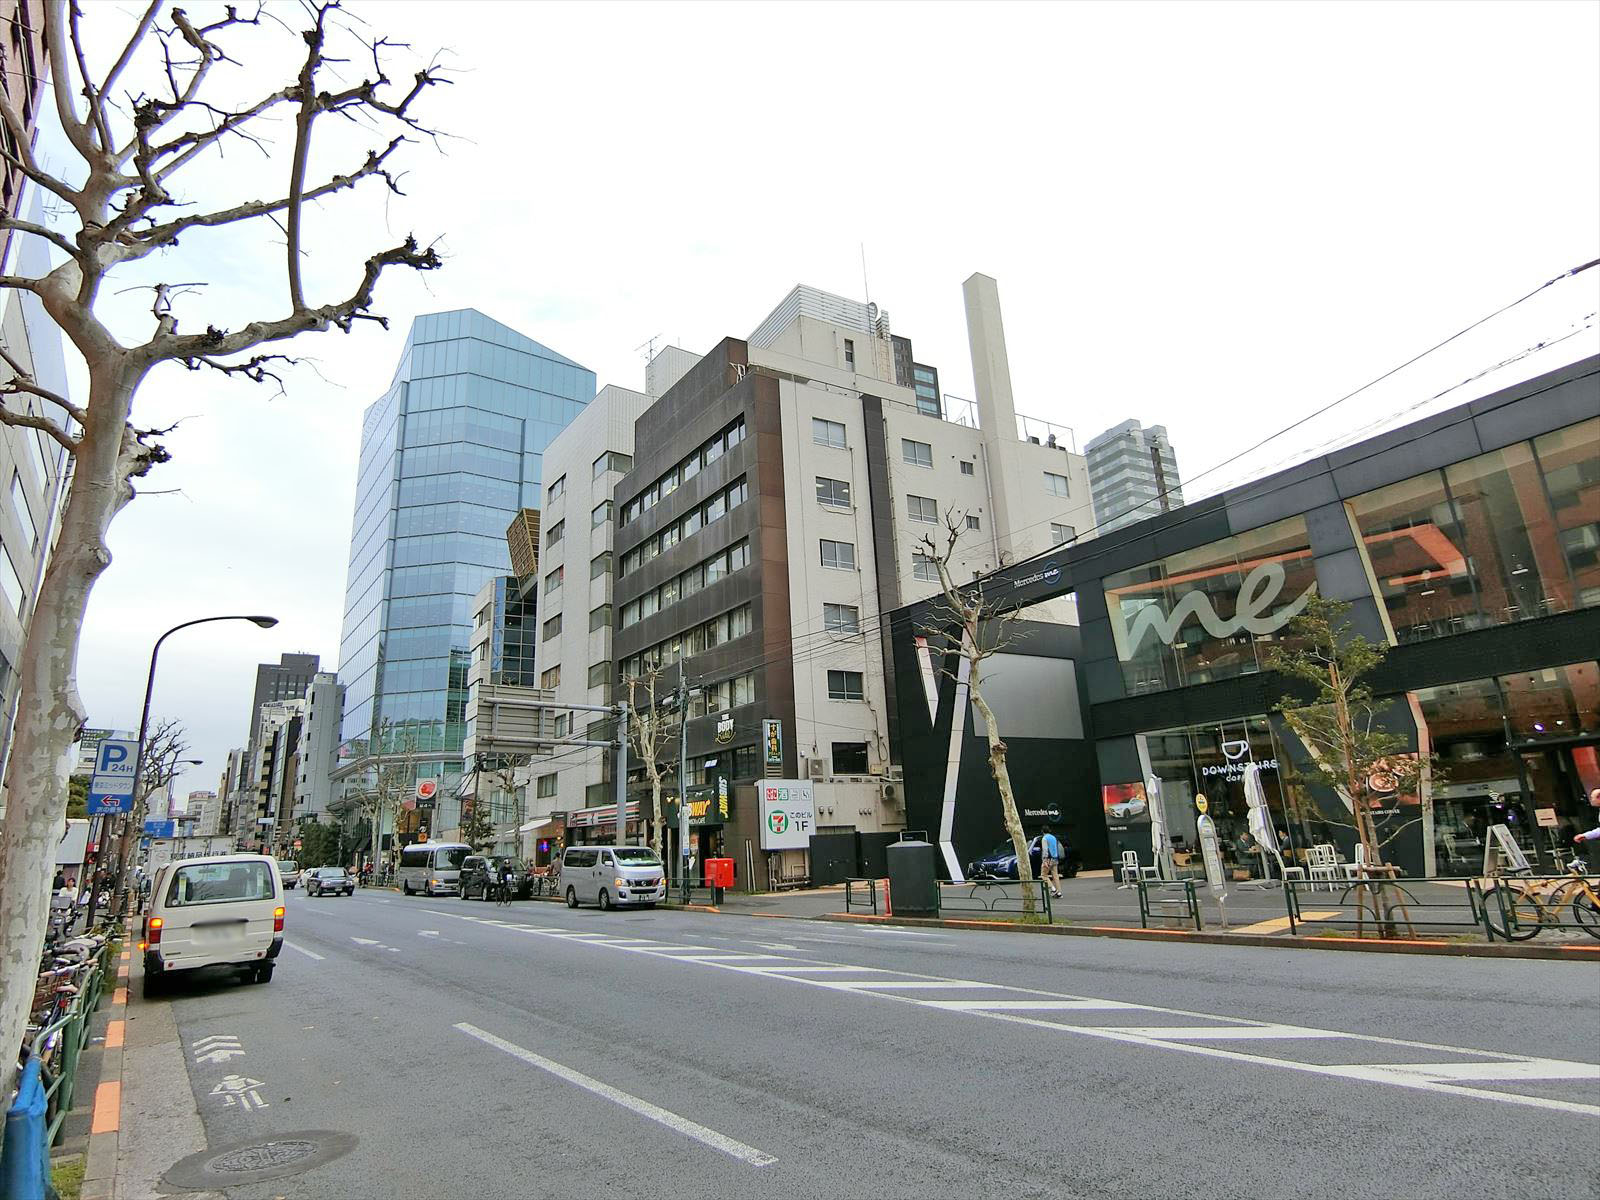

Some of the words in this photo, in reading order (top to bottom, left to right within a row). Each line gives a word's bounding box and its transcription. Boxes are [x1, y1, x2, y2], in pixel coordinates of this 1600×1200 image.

[1013, 573, 1044, 588] Mercedes
[1044, 568, 1059, 578] me
[1117, 562, 1319, 662] me
[717, 719, 734, 733] BODY
[101, 744, 128, 772] P
[112, 764, 133, 773] 24H
[718, 776, 728, 818] SUBWAY
[795, 821, 808, 832] 1F
